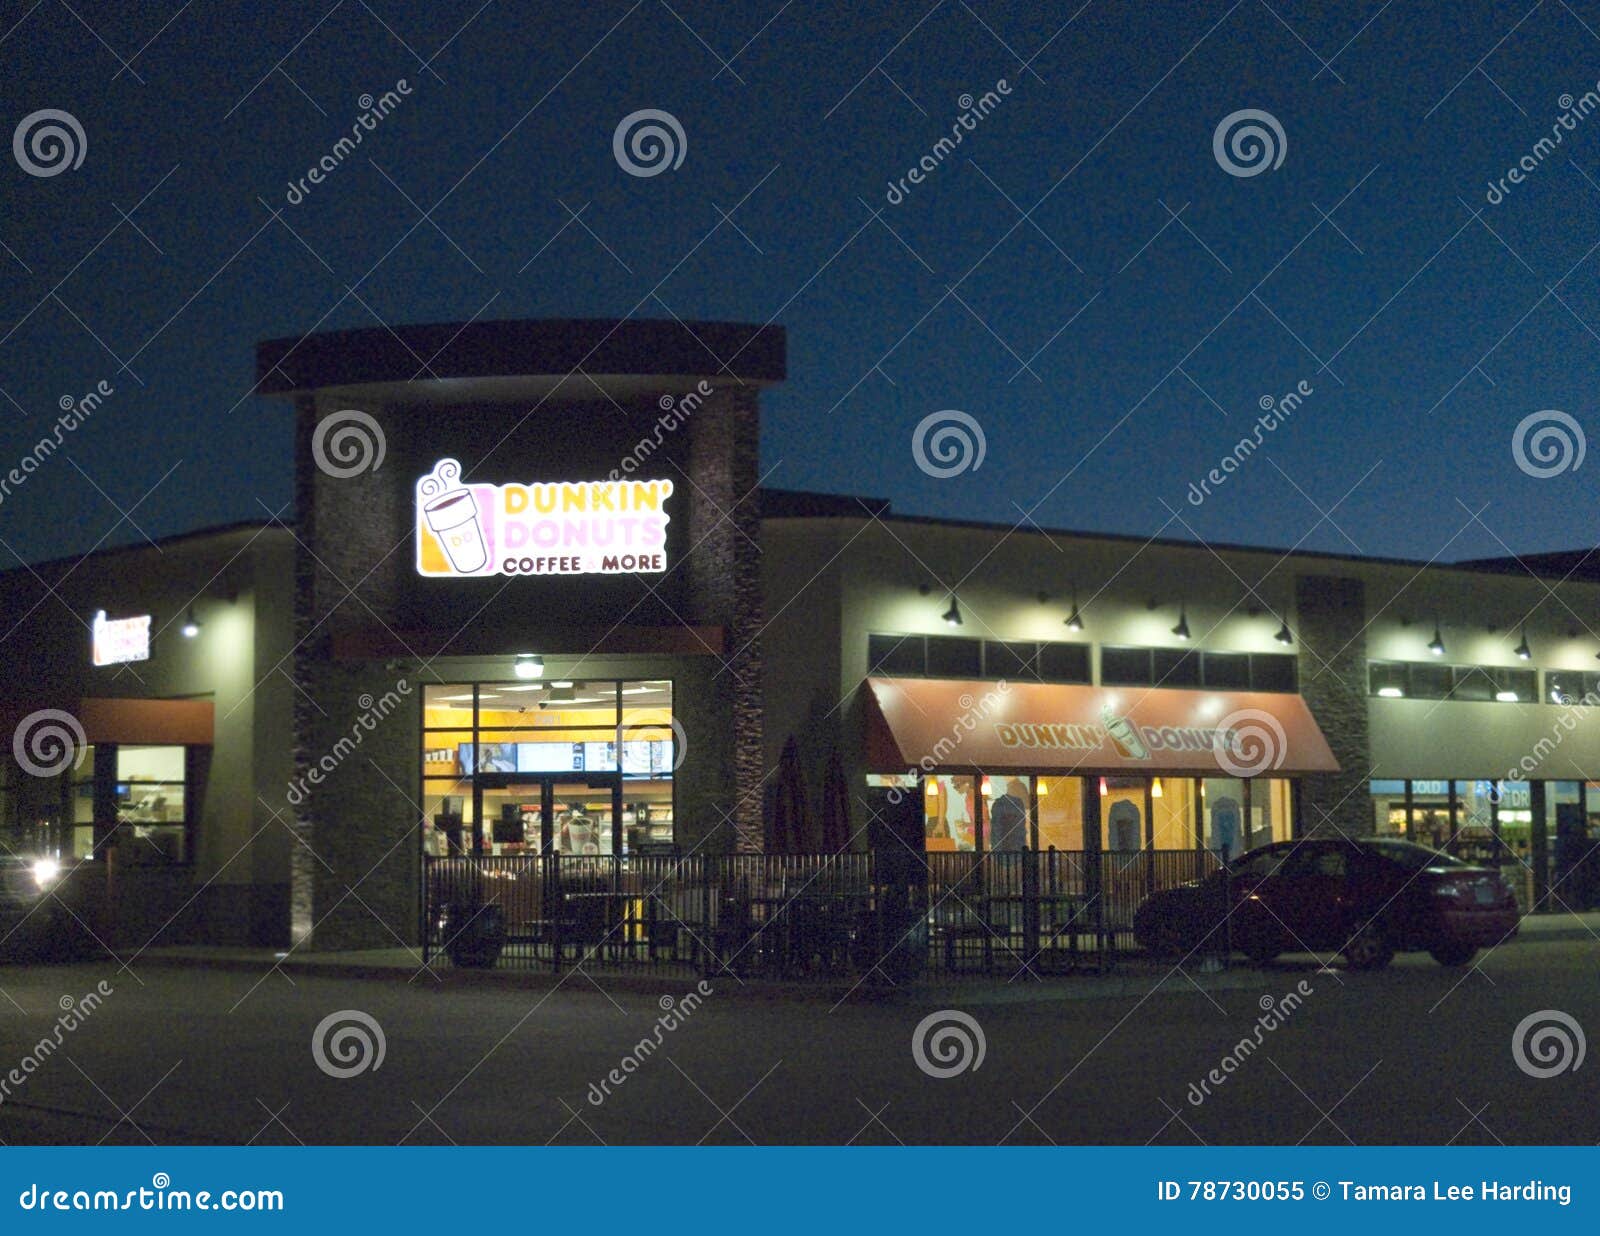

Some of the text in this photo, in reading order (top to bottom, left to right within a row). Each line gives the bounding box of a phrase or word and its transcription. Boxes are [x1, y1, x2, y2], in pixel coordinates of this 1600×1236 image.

[504, 483, 671, 515] DUNKIN'
[504, 517, 662, 549] DONUTS
[503, 557, 581, 573] COFFEE
[602, 554, 662, 571] MORE
